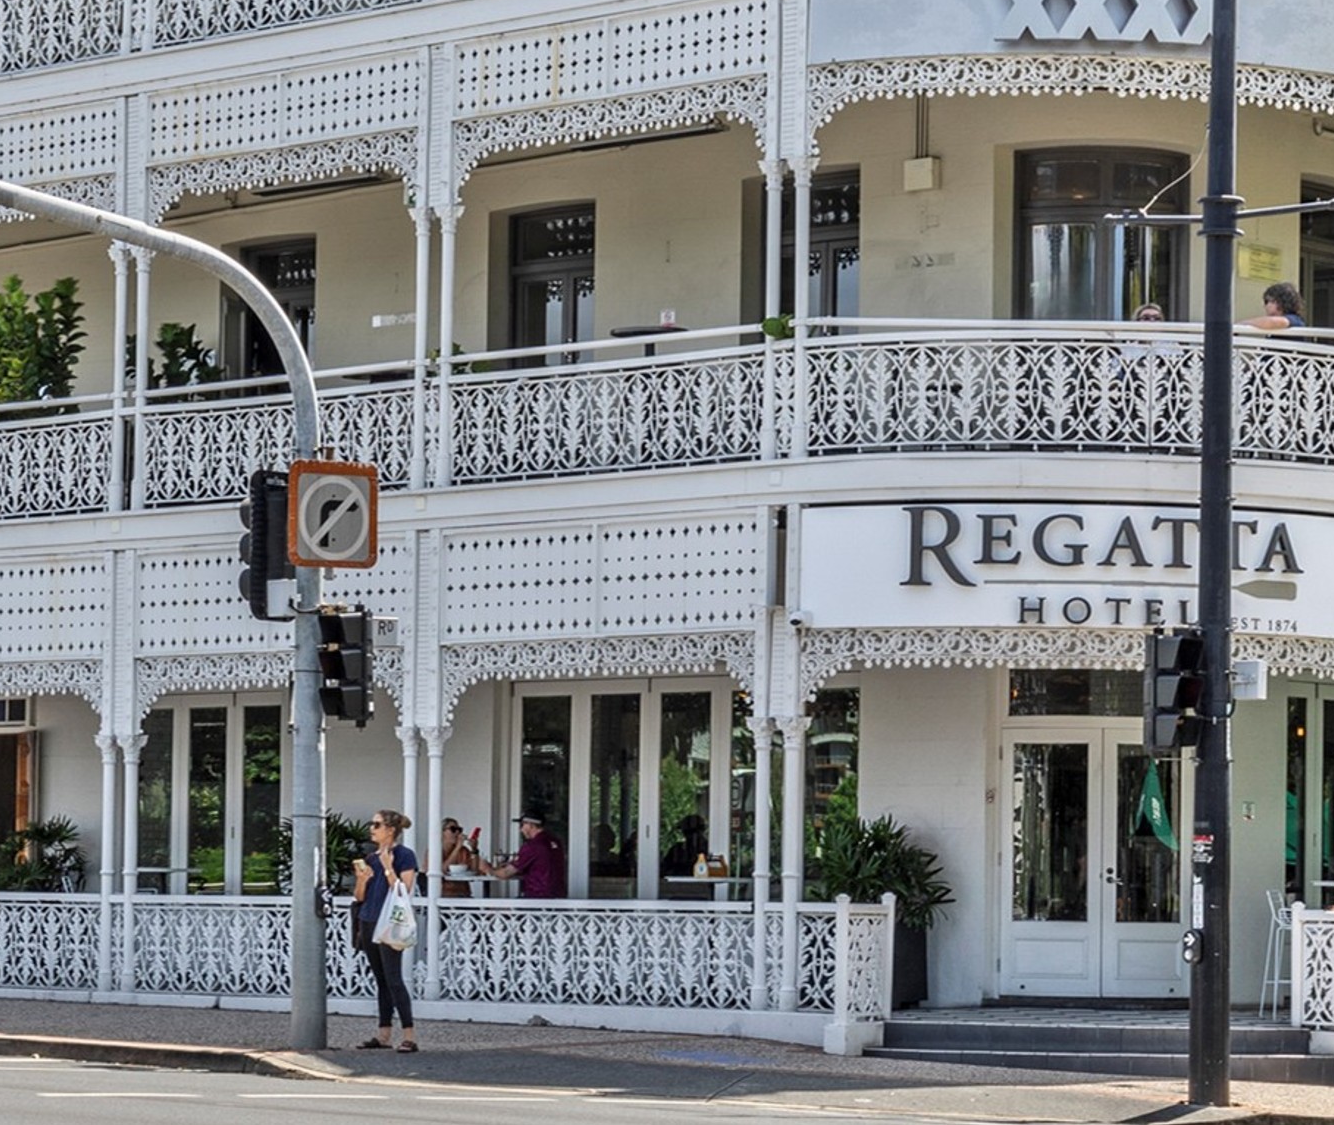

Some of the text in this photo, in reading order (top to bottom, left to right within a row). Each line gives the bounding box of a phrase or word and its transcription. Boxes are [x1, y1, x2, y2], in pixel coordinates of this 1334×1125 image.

[899, 506, 1305, 587] REGATTA
[1018, 596, 1199, 626] HOTEL
[1230, 617, 1298, 632] EST 1874
